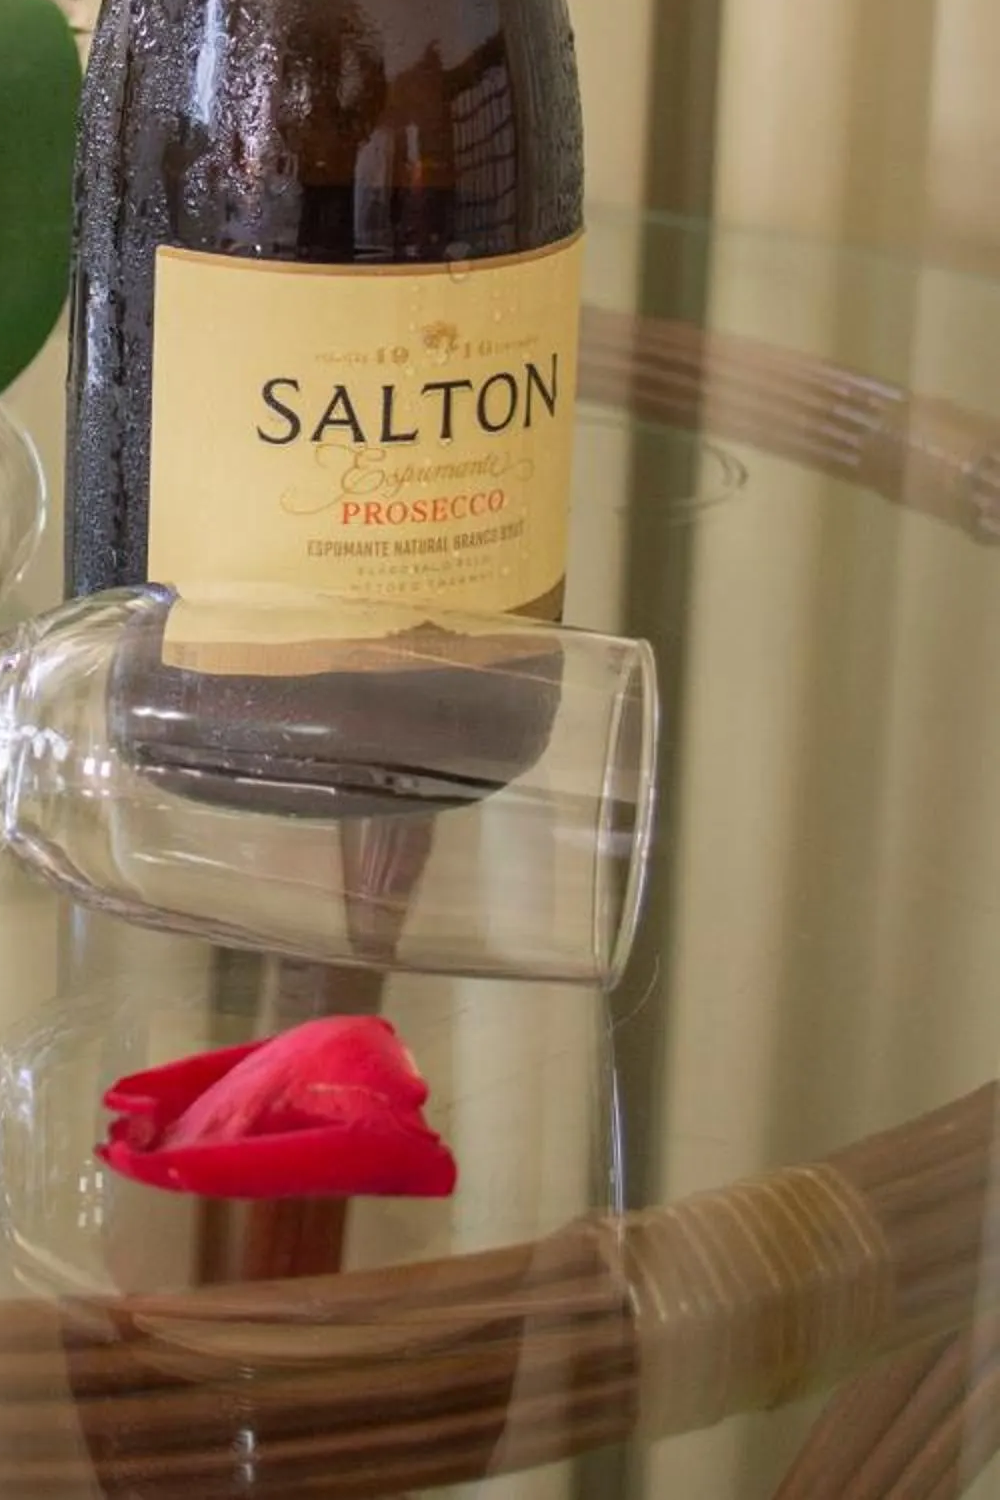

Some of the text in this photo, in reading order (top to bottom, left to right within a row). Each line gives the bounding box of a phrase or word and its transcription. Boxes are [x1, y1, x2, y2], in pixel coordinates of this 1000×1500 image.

[256, 353, 558, 445] SALTON
[340, 488, 506, 526] PROSECCO
[306, 539, 389, 558] ESPUMANTE
[394, 536, 448, 557] NATURAL
